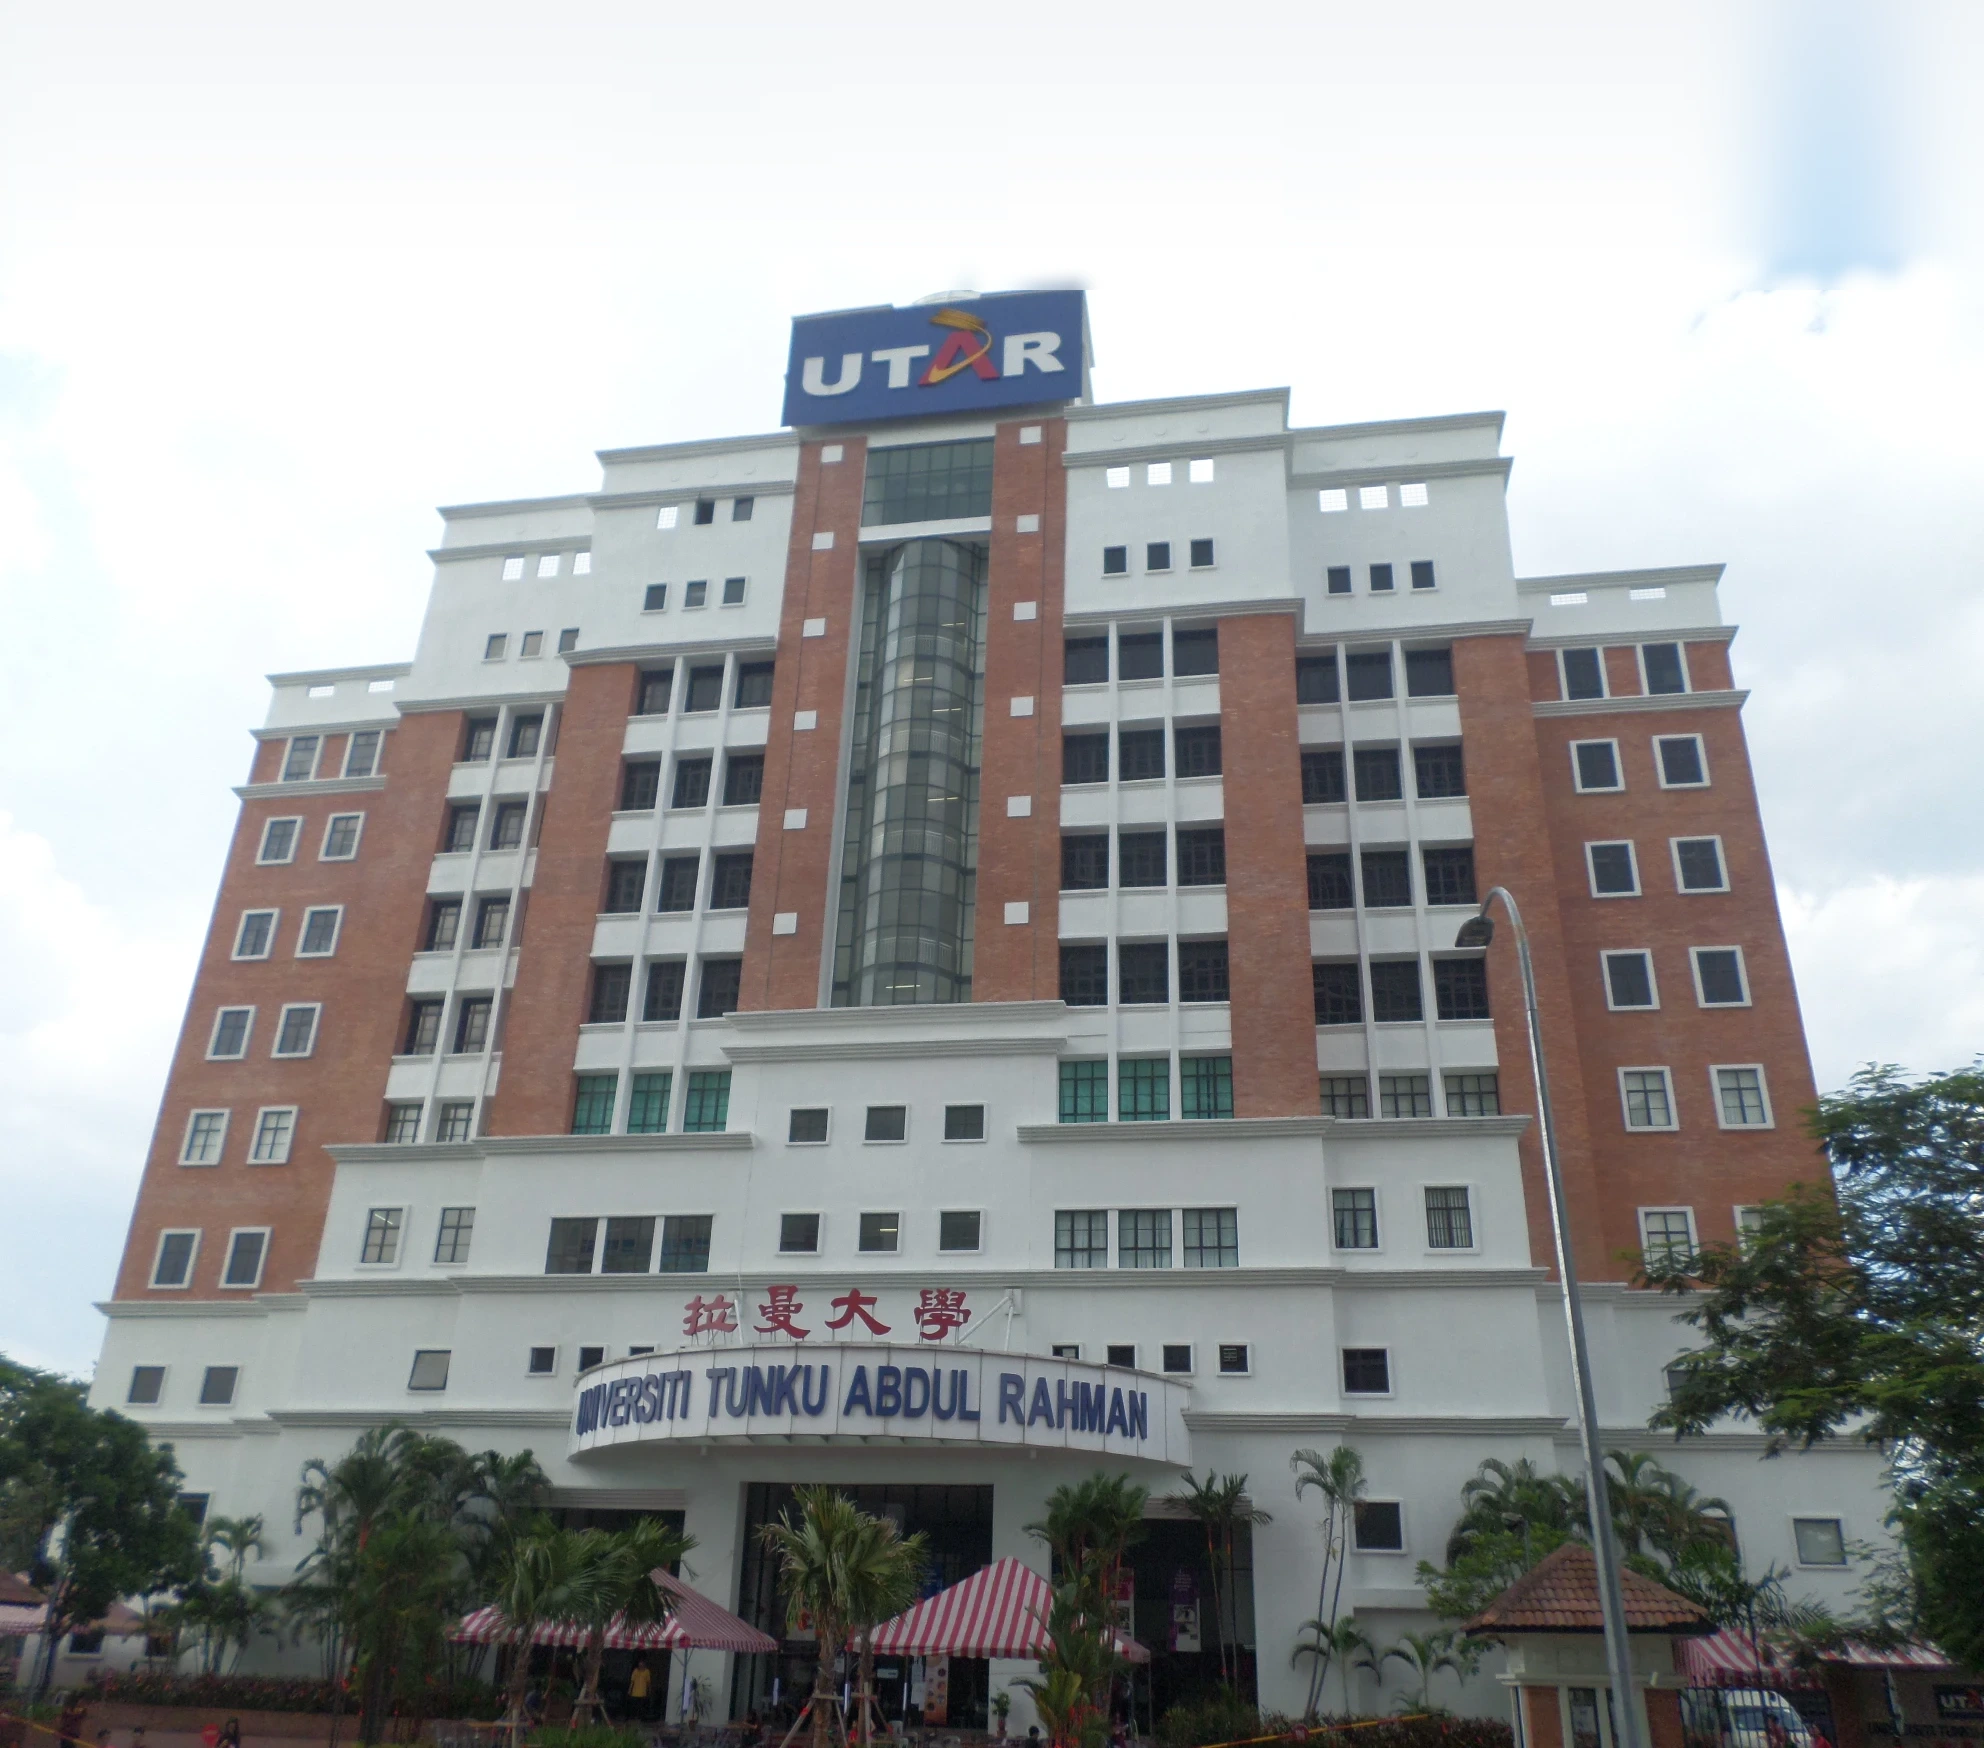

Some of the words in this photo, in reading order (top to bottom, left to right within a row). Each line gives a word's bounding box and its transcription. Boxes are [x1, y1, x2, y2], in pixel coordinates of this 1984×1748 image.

[802, 330, 1065, 396] UTAR
[682, 1285, 972, 1339] 拉曼大學
[576, 1369, 692, 1437] UNIVERSITI
[705, 1364, 829, 1418] TUNKU
[842, 1364, 981, 1421] ABDUL
[999, 1372, 1148, 1440] RAHMAN
